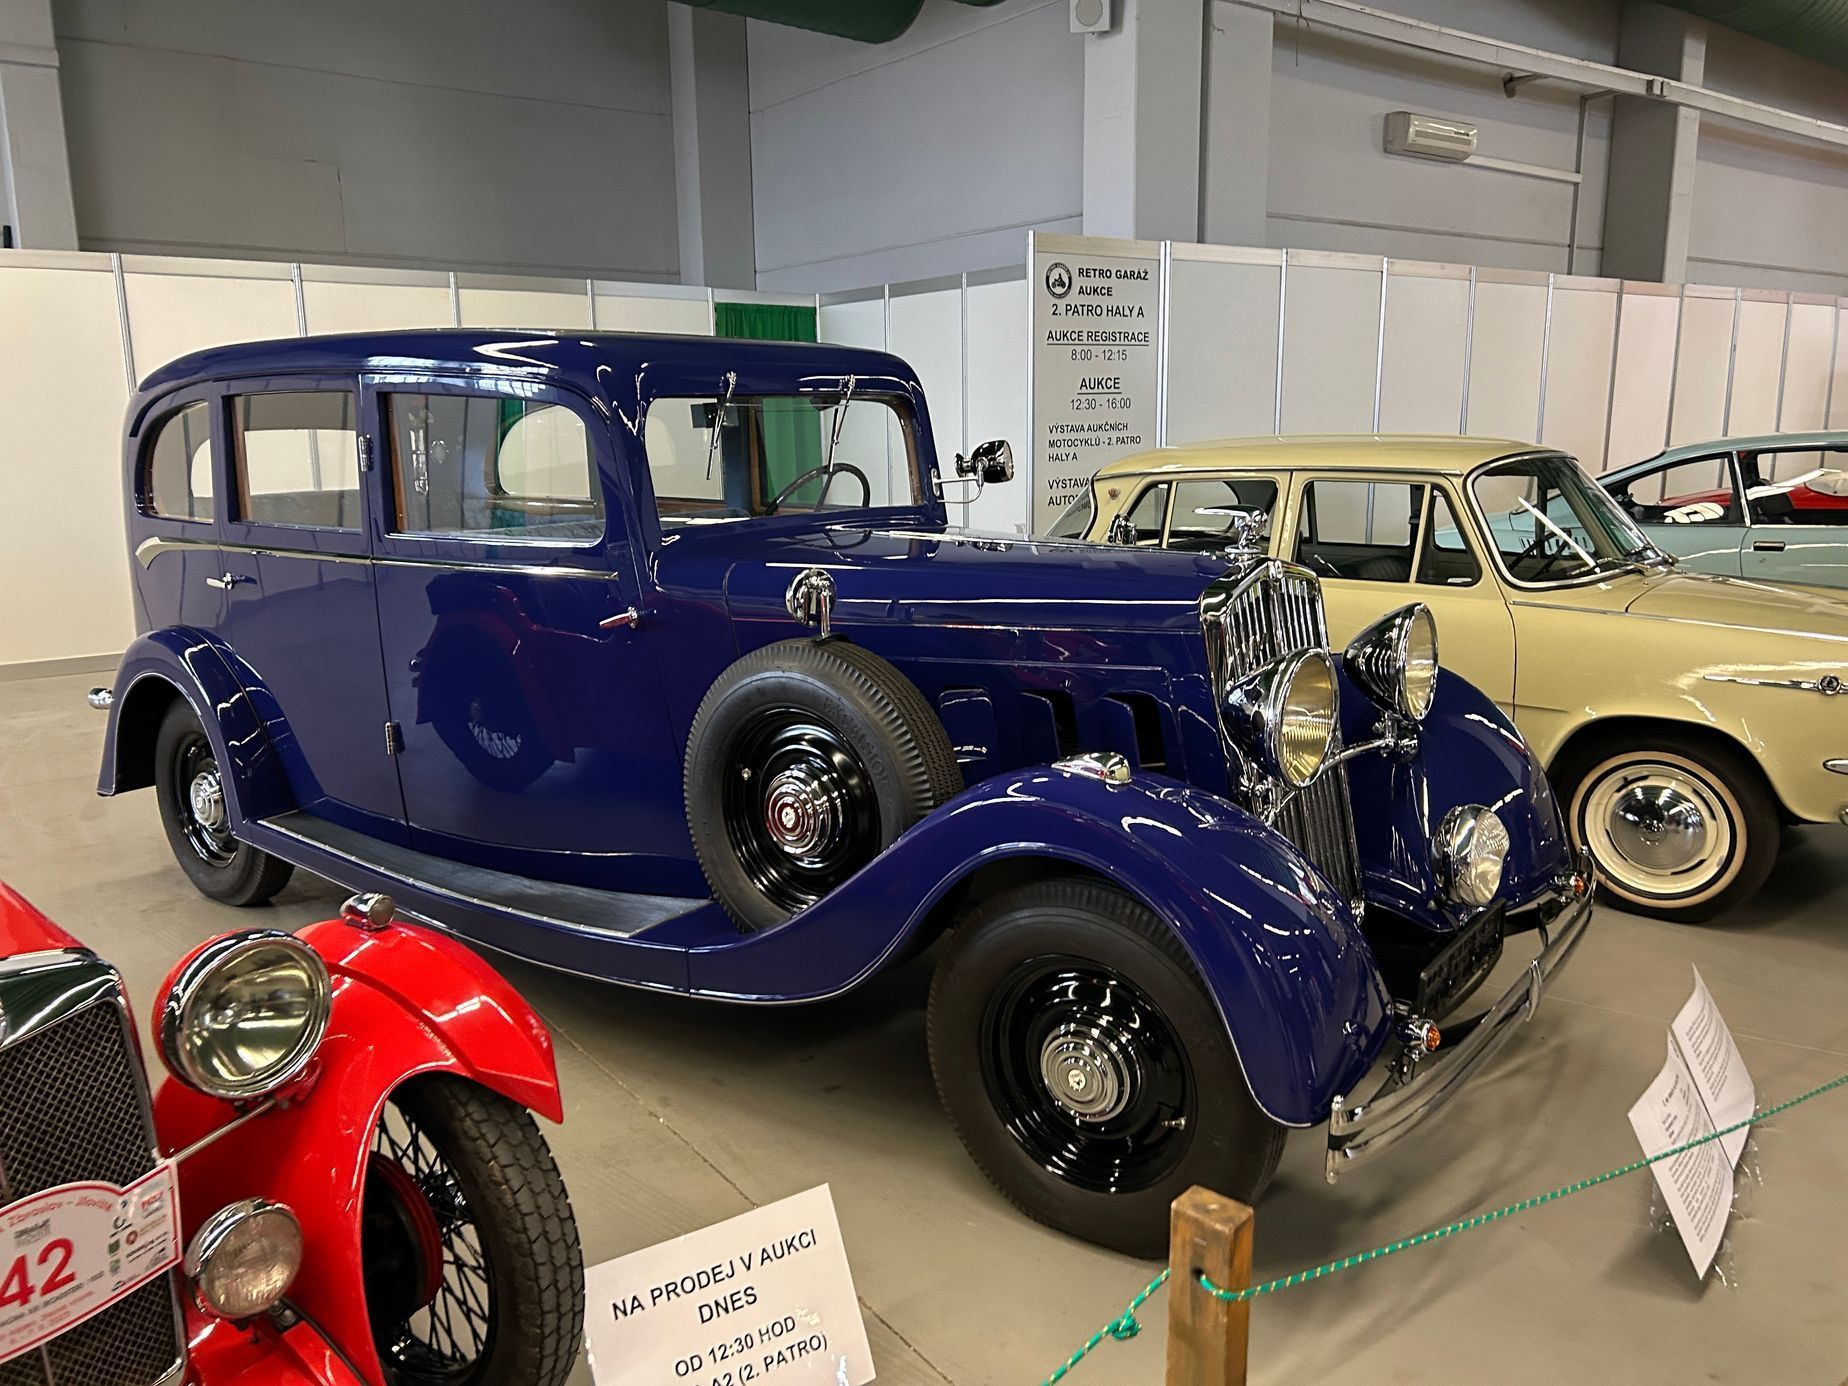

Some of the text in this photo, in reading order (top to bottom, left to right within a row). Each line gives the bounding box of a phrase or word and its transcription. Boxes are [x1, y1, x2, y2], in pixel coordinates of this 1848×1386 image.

[1078, 268, 1149, 281] RETRO GARÁŽ
[1078, 285, 1113, 297] AUKCE
[1052, 303, 1145, 318] 2. PATRO HALY A
[1047, 330, 1149, 343] AUKCE REGISTRACE
[1071, 349, 1092, 361] 8:00
[1101, 349, 1128, 361] 12:15
[1080, 377, 1120, 390] AUKCE
[1070, 398, 1097, 410] 12:30
[1106, 397, 1131, 409] 16:00
[1048, 421, 1128, 434] VÝSTAVA AUKČNÍCH
[1048, 436, 1100, 448] MOTOCYKLŮ
[1107, 437, 1114, 446] 2.
[1116, 436, 1141, 446] PATRO
[1048, 452, 1078, 462] HALY A
[1047, 477, 1090, 490] VÝSTAVA
[1047, 494, 1079, 506] AUTO
[0, 1237, 76, 1306] 42
[612, 1229, 817, 1321] NA PRODEJ V AUKCI
[698, 1286, 758, 1324] DNES
[675, 1315, 796, 1378] OD 12:30 HOD
[738, 1363, 760, 1386] (2.
[764, 1333, 828, 1373] PATRO)
